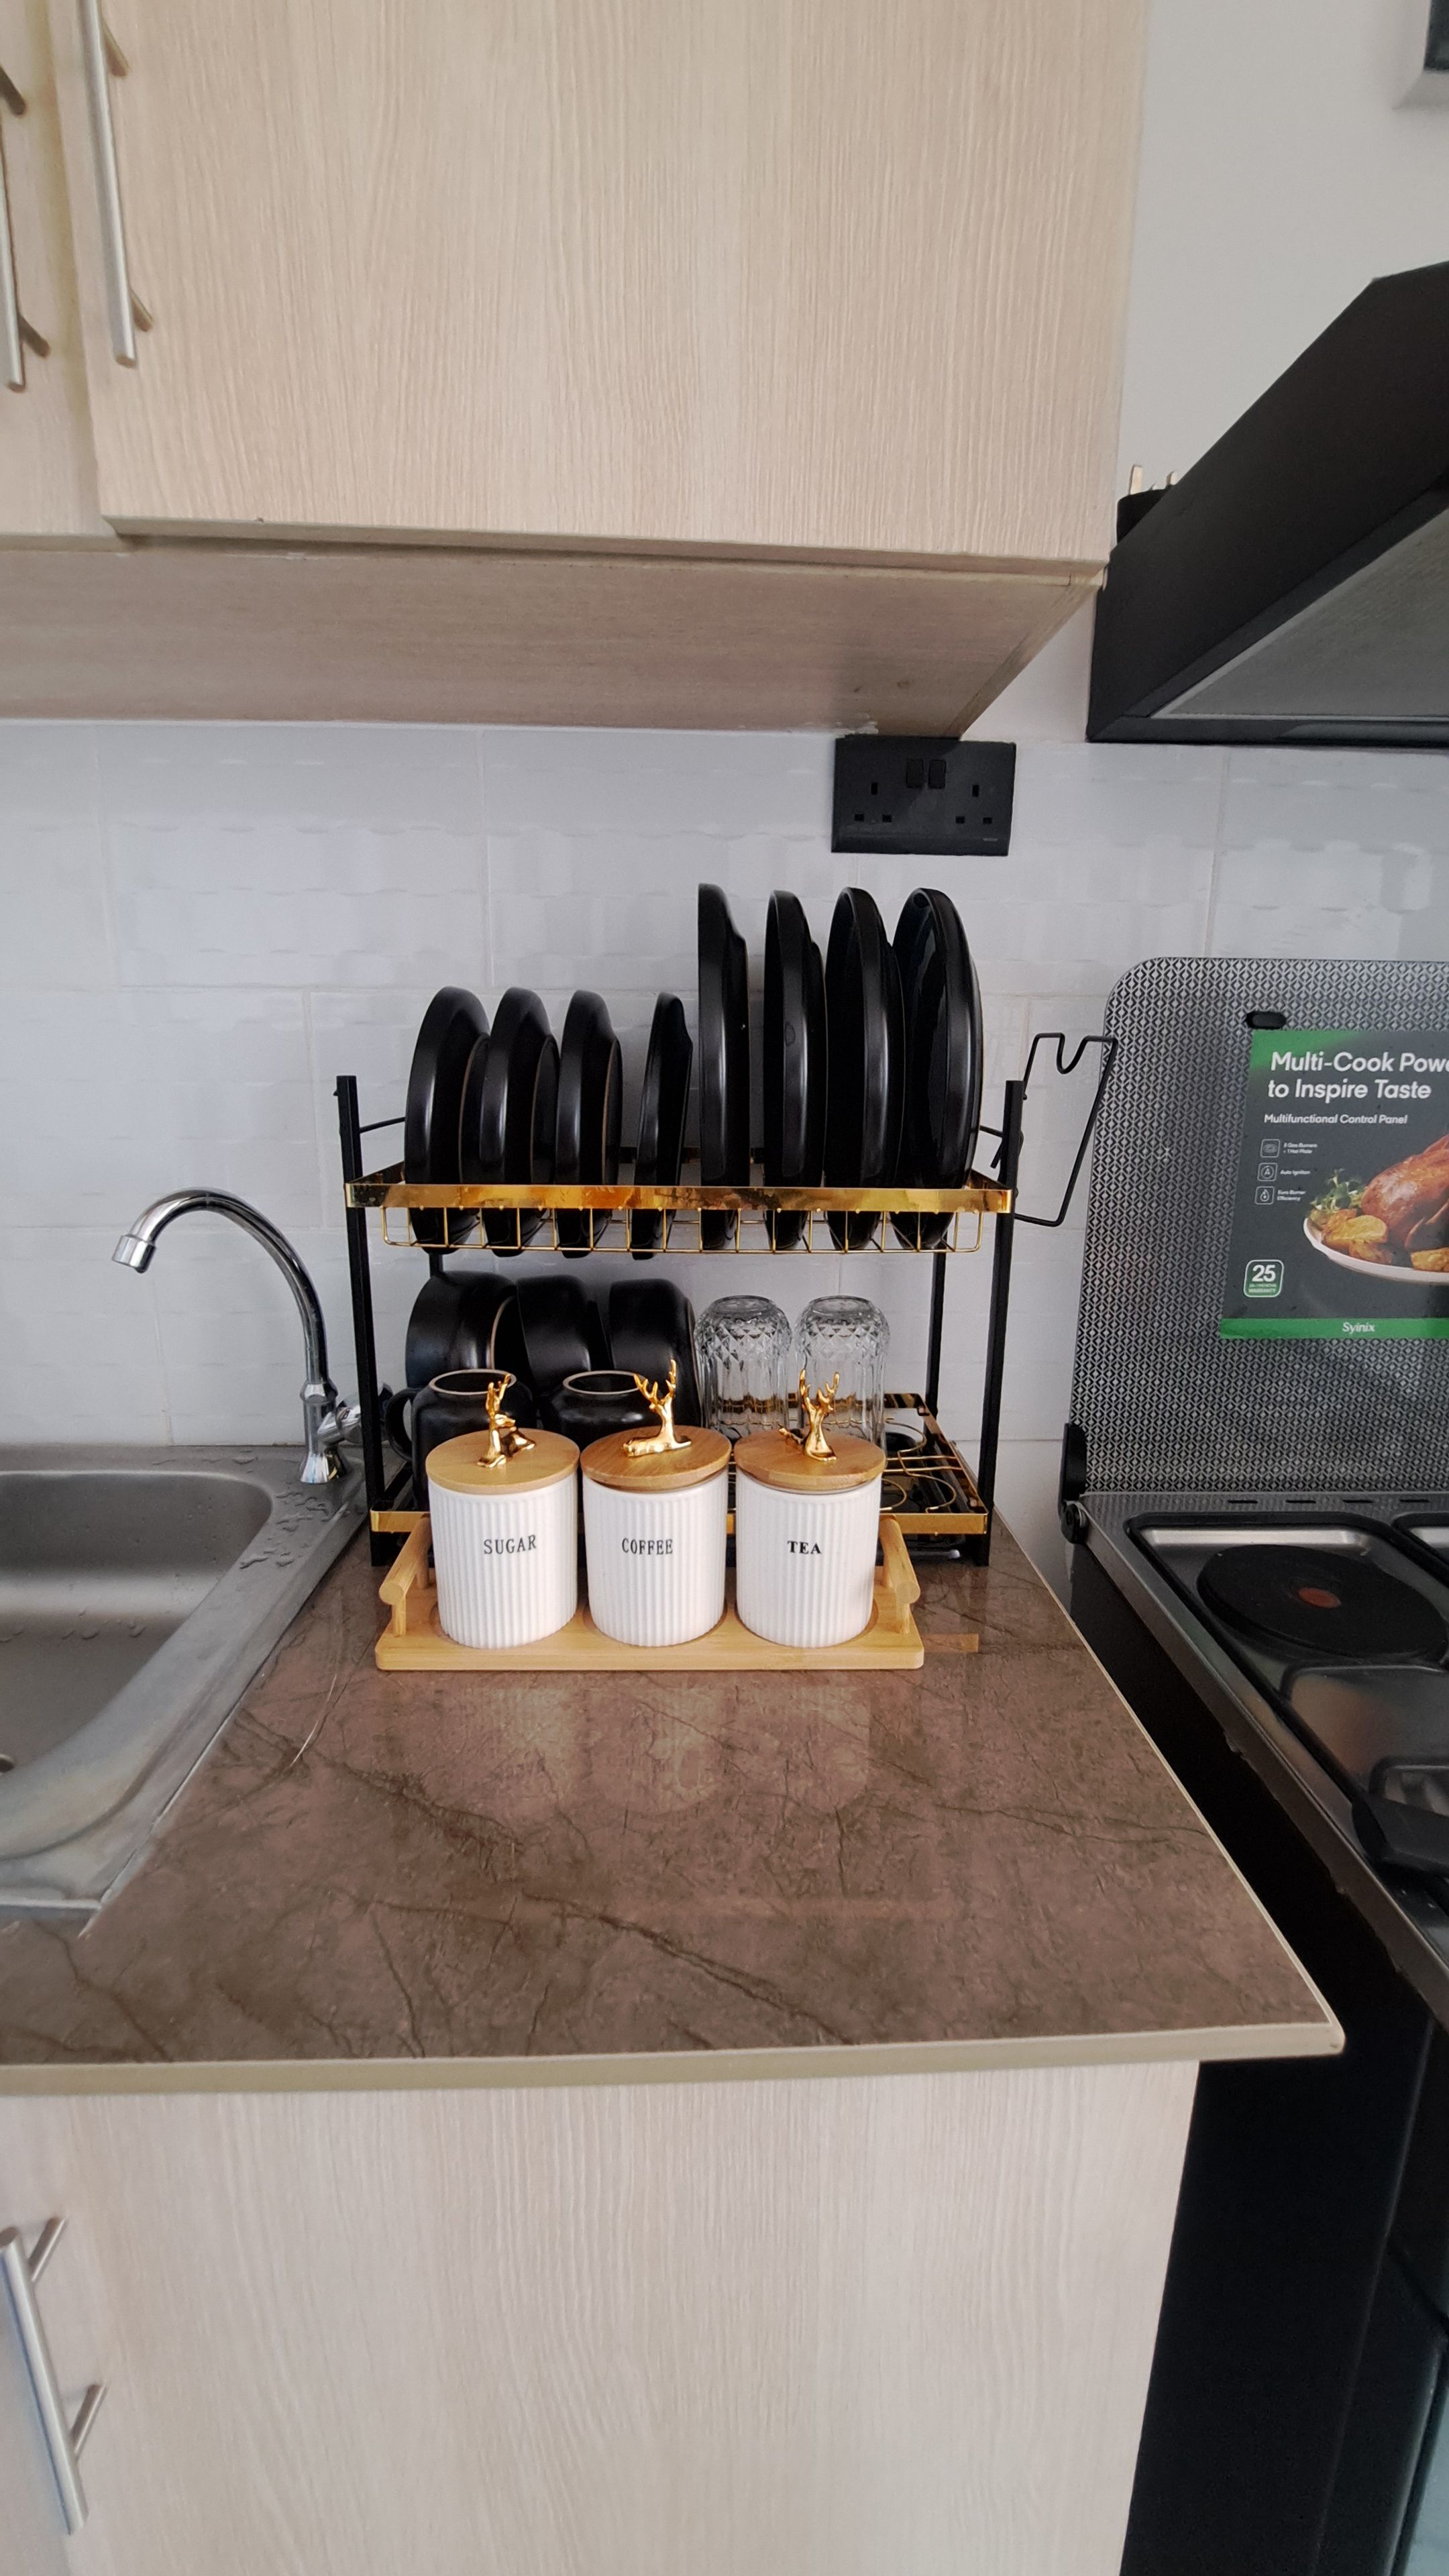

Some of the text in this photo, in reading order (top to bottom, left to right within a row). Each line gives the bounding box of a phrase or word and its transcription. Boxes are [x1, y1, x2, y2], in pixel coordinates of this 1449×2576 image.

[1271, 1051, 1395, 1072] Multi-Cook
[1268, 1078, 1432, 1104] to Inspire Taste
[1264, 1114, 1408, 1124] Multifunctional Control Panel
[1252, 1265, 1276, 1282] 25
[1342, 1322, 1375, 1334] Syinix
[483, 1534, 537, 1555] SUGAR
[621, 1538, 673, 1555] COFFEE
[787, 1540, 822, 1555] TEA
